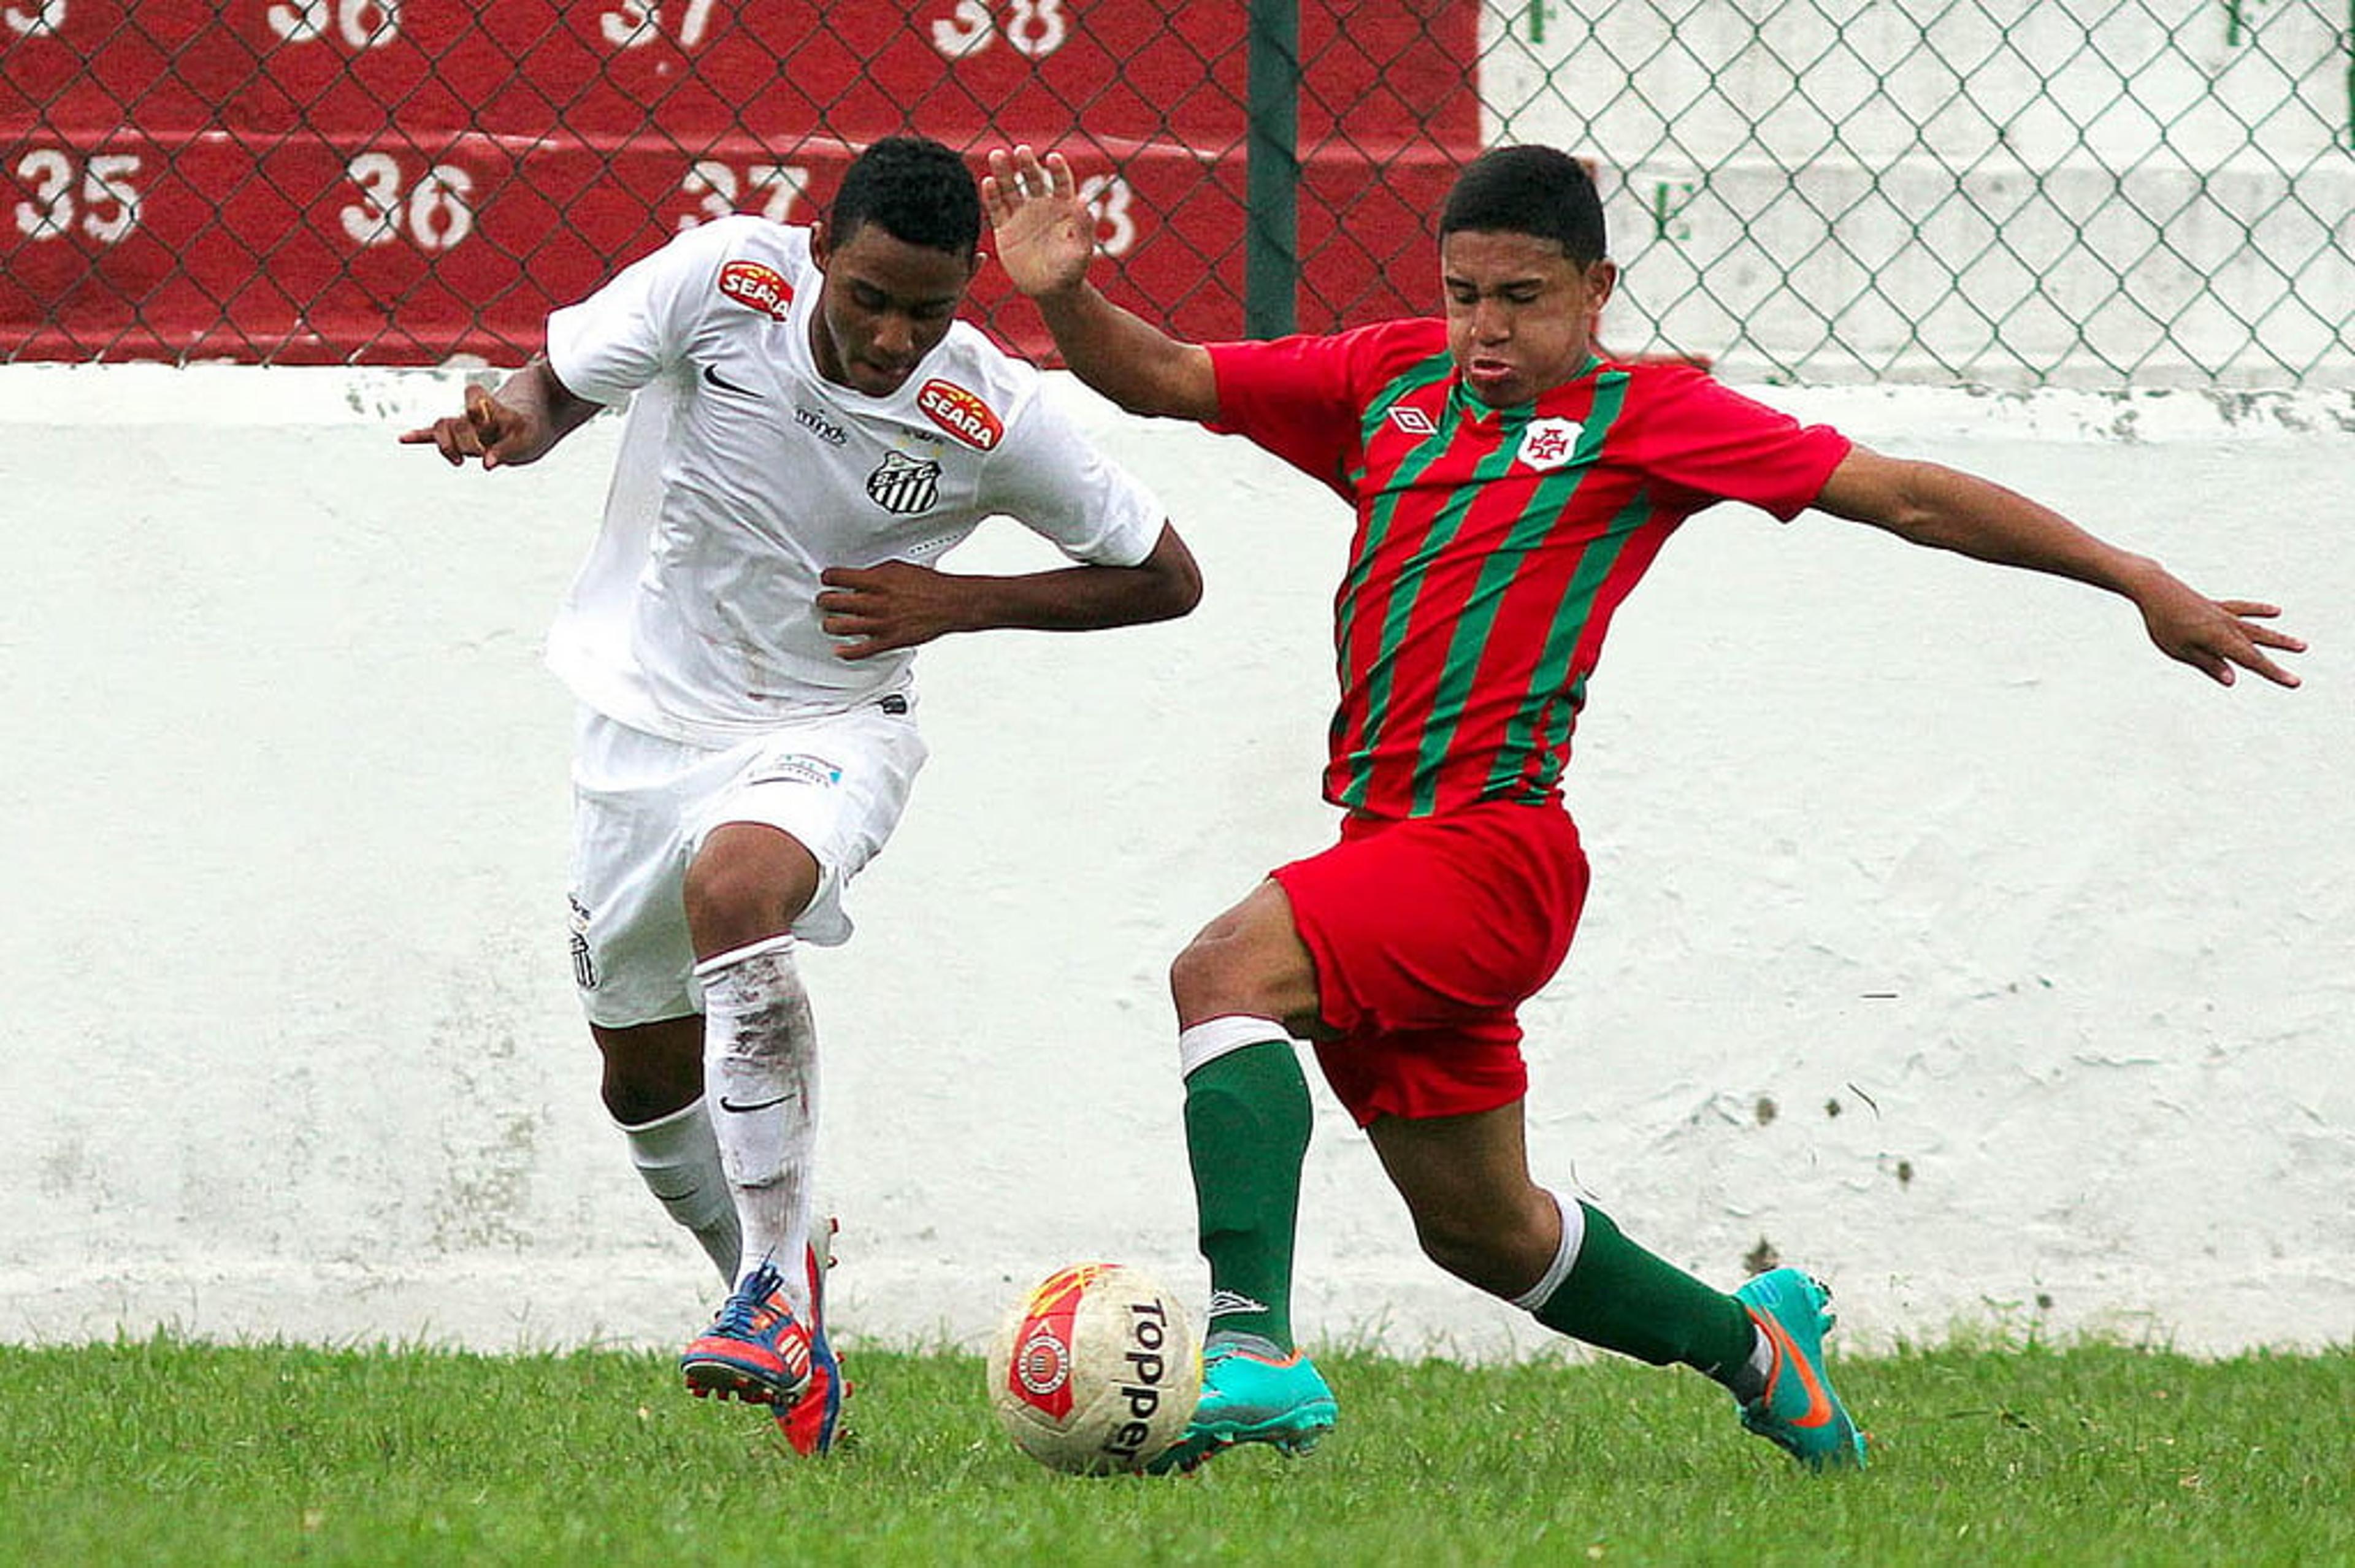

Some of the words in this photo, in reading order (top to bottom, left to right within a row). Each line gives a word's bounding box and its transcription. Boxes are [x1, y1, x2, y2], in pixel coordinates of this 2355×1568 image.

[932, 0, 1065, 57] 38
[15, 150, 140, 242] 35
[340, 153, 472, 249] 36
[678, 161, 809, 227] 37
[723, 273, 791, 317] SEARA
[921, 390, 992, 447] SEARA
[1101, 1298, 1168, 1461] Topper
